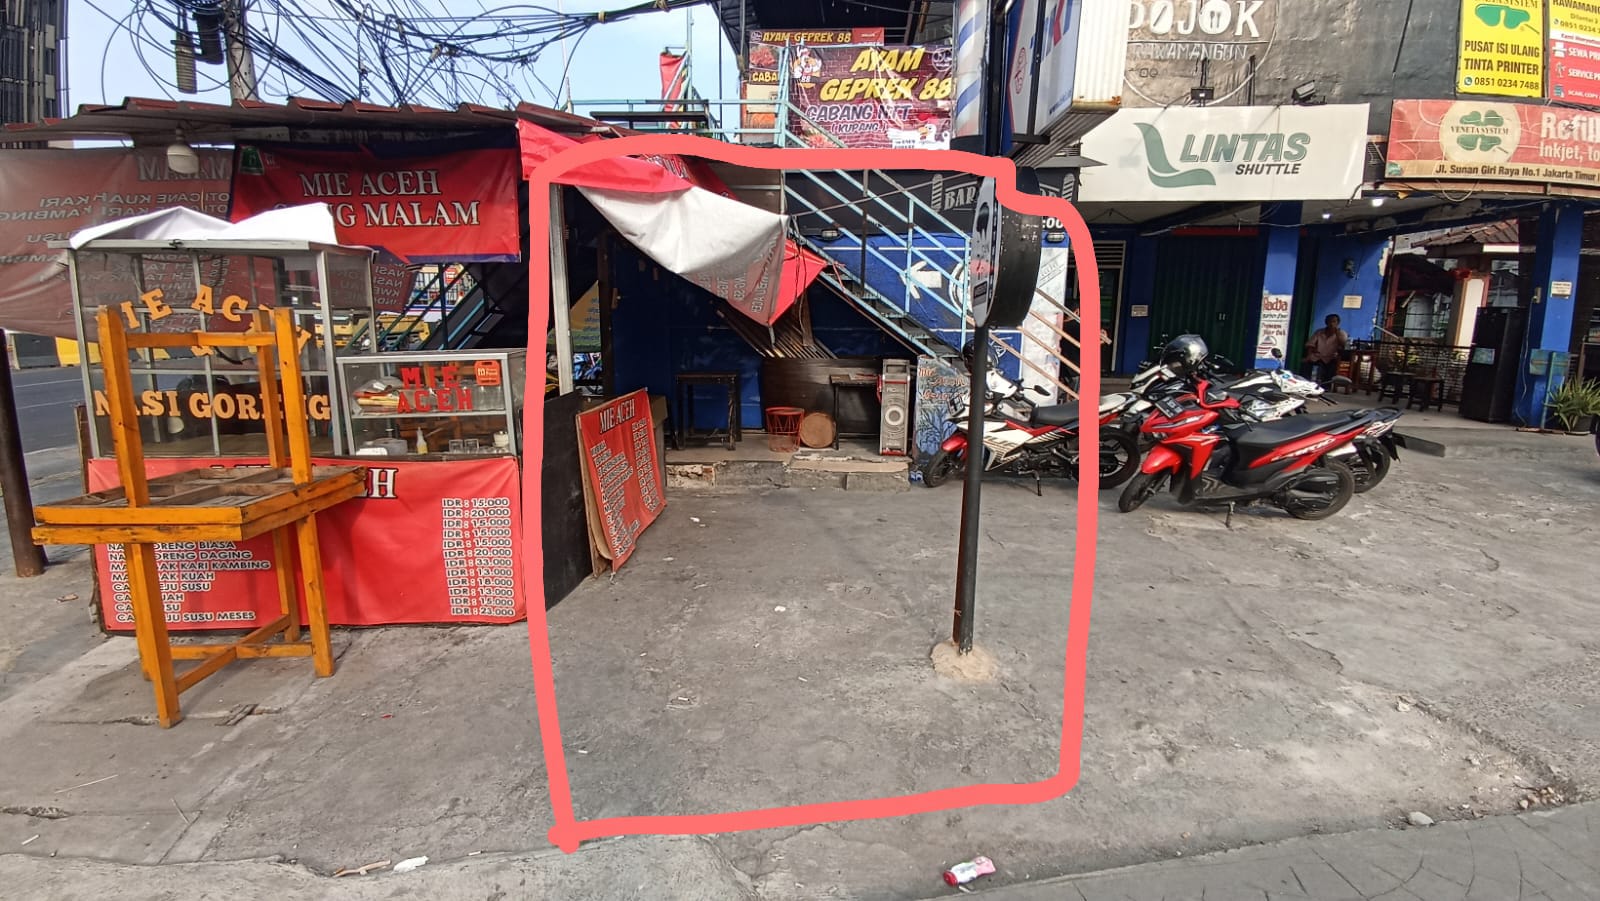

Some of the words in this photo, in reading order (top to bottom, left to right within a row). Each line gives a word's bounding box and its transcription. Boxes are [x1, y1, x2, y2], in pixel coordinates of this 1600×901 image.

[763, 32, 790, 42] AYAM
[794, 32, 833, 43] GEPREK
[837, 32, 852, 43] 88
[1465, 40, 1494, 53] PUSAT
[1496, 42, 1508, 54] ISI
[1511, 44, 1540, 58] ULANG
[851, 47, 925, 73] AYAM
[1464, 58, 1493, 71] TINTA
[1497, 60, 1539, 75] PRINTER
[1474, 77, 1495, 86] 0851
[1497, 78, 1518, 88] 0234
[820, 78, 918, 101] GEPREK
[919, 78, 952, 100] 88
[807, 104, 873, 121] CABANG
[1180, 132, 1311, 163] LINTAS
[1235, 163, 1302, 176] SHUTTLE
[1435, 164, 1447, 174] Jl.
[1449, 165, 1478, 175] Sunan
[1481, 165, 1497, 175] Giri
[1499, 166, 1520, 177] Raya
[1522, 167, 1540, 177] No.1
[1543, 168, 1574, 179] Jakarta
[1575, 170, 1596, 181] Timur
[300, 173, 352, 197] MIE
[360, 169, 441, 196] ACEH
[365, 201, 480, 228] MALAM
[400, 366, 460, 390] MIE
[94, 390, 181, 416] NSI
[189, 392, 331, 421] GORG
[397, 388, 473, 414] ACEH
[600, 406, 616, 434] MIE
[615, 398, 635, 425] ACEH
[443, 499, 462, 507] IDR
[472, 498, 509, 507] 15.000
[443, 509, 462, 517] IDR
[471, 508, 510, 517] 20.000
[443, 519, 462, 528] IDR
[443, 530, 462, 538] IDR
[443, 540, 463, 549] IDR
[155, 552, 196, 560] RENG
[444, 550, 465, 558] IDR
[180, 562, 208, 570] KARI
[212, 561, 270, 569] KAMBING
[447, 569, 467, 577] IDR
[449, 588, 469, 596] IDR
[217, 612, 254, 620] MESES
[452, 607, 470, 615] IDR
